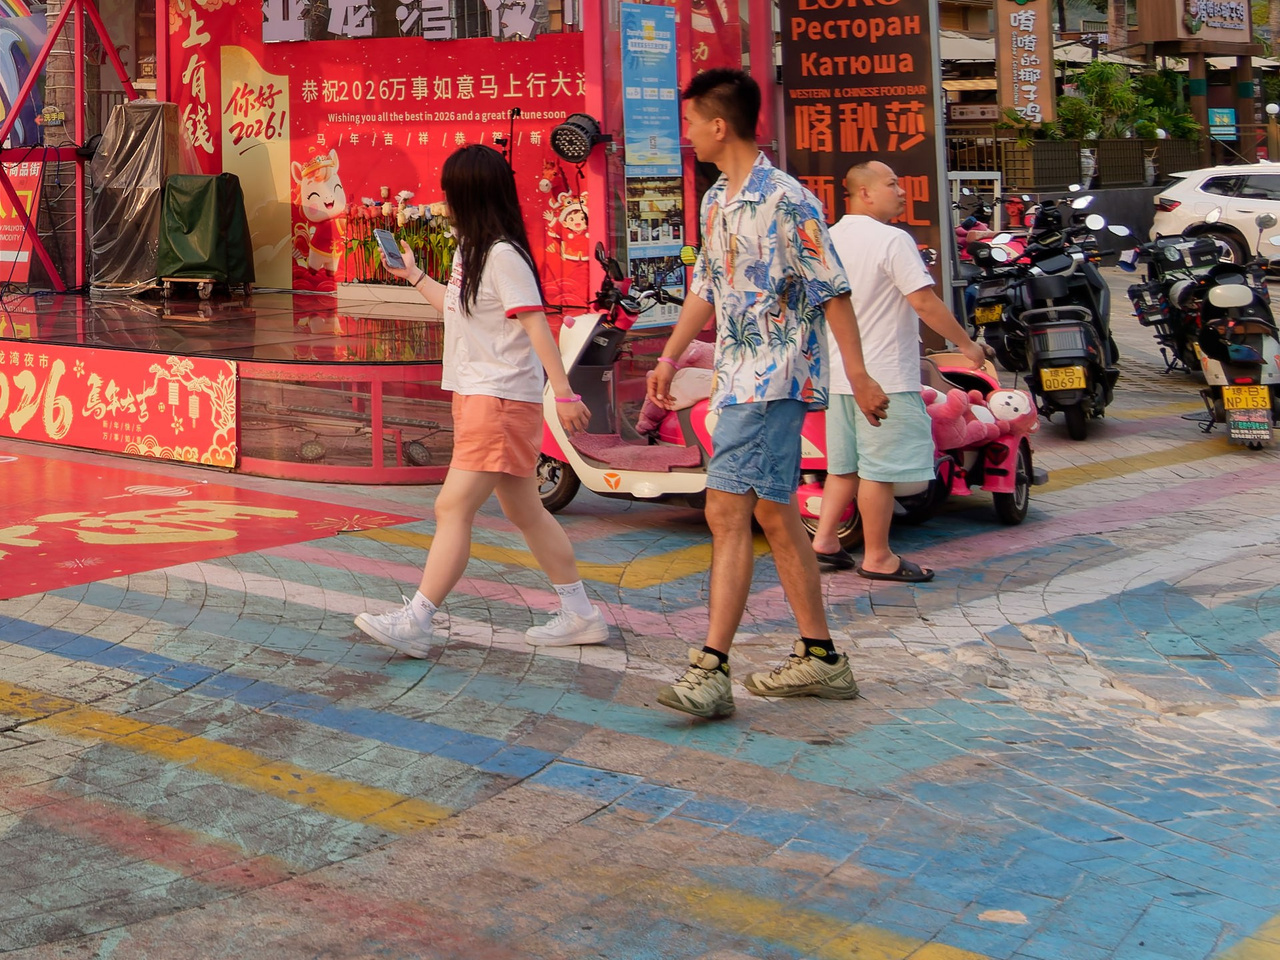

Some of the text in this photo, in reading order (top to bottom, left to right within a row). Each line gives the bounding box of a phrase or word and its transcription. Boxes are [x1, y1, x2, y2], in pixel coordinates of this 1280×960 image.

[791, 15, 920, 43] Ресторан
[801, 52, 913, 76] Катюша
[223, 82, 283, 117] 你好
[789, 89, 831, 99] WESTERN
[842, 87, 879, 97] CHINESE
[879, 86, 907, 96] FOOD
[907, 85, 926, 95] BAR
[228, 110, 286, 146] 2026!
[328, 113, 360, 124] Wishing
[360, 114, 376, 123] you
[377, 112, 389, 122] all
[390, 112, 404, 122] the
[404, 112, 424, 121] best
[424, 111, 433, 121] in
[434, 111, 455, 121] 2026
[456, 110, 473, 121] and
[482, 111, 504, 123] great
[543, 110, 566, 119] soon
[794, 100, 925, 153] 喀秋莎
[1045, 377, 1082, 389] QD697
[1227, 397, 1267, 408] NP153
